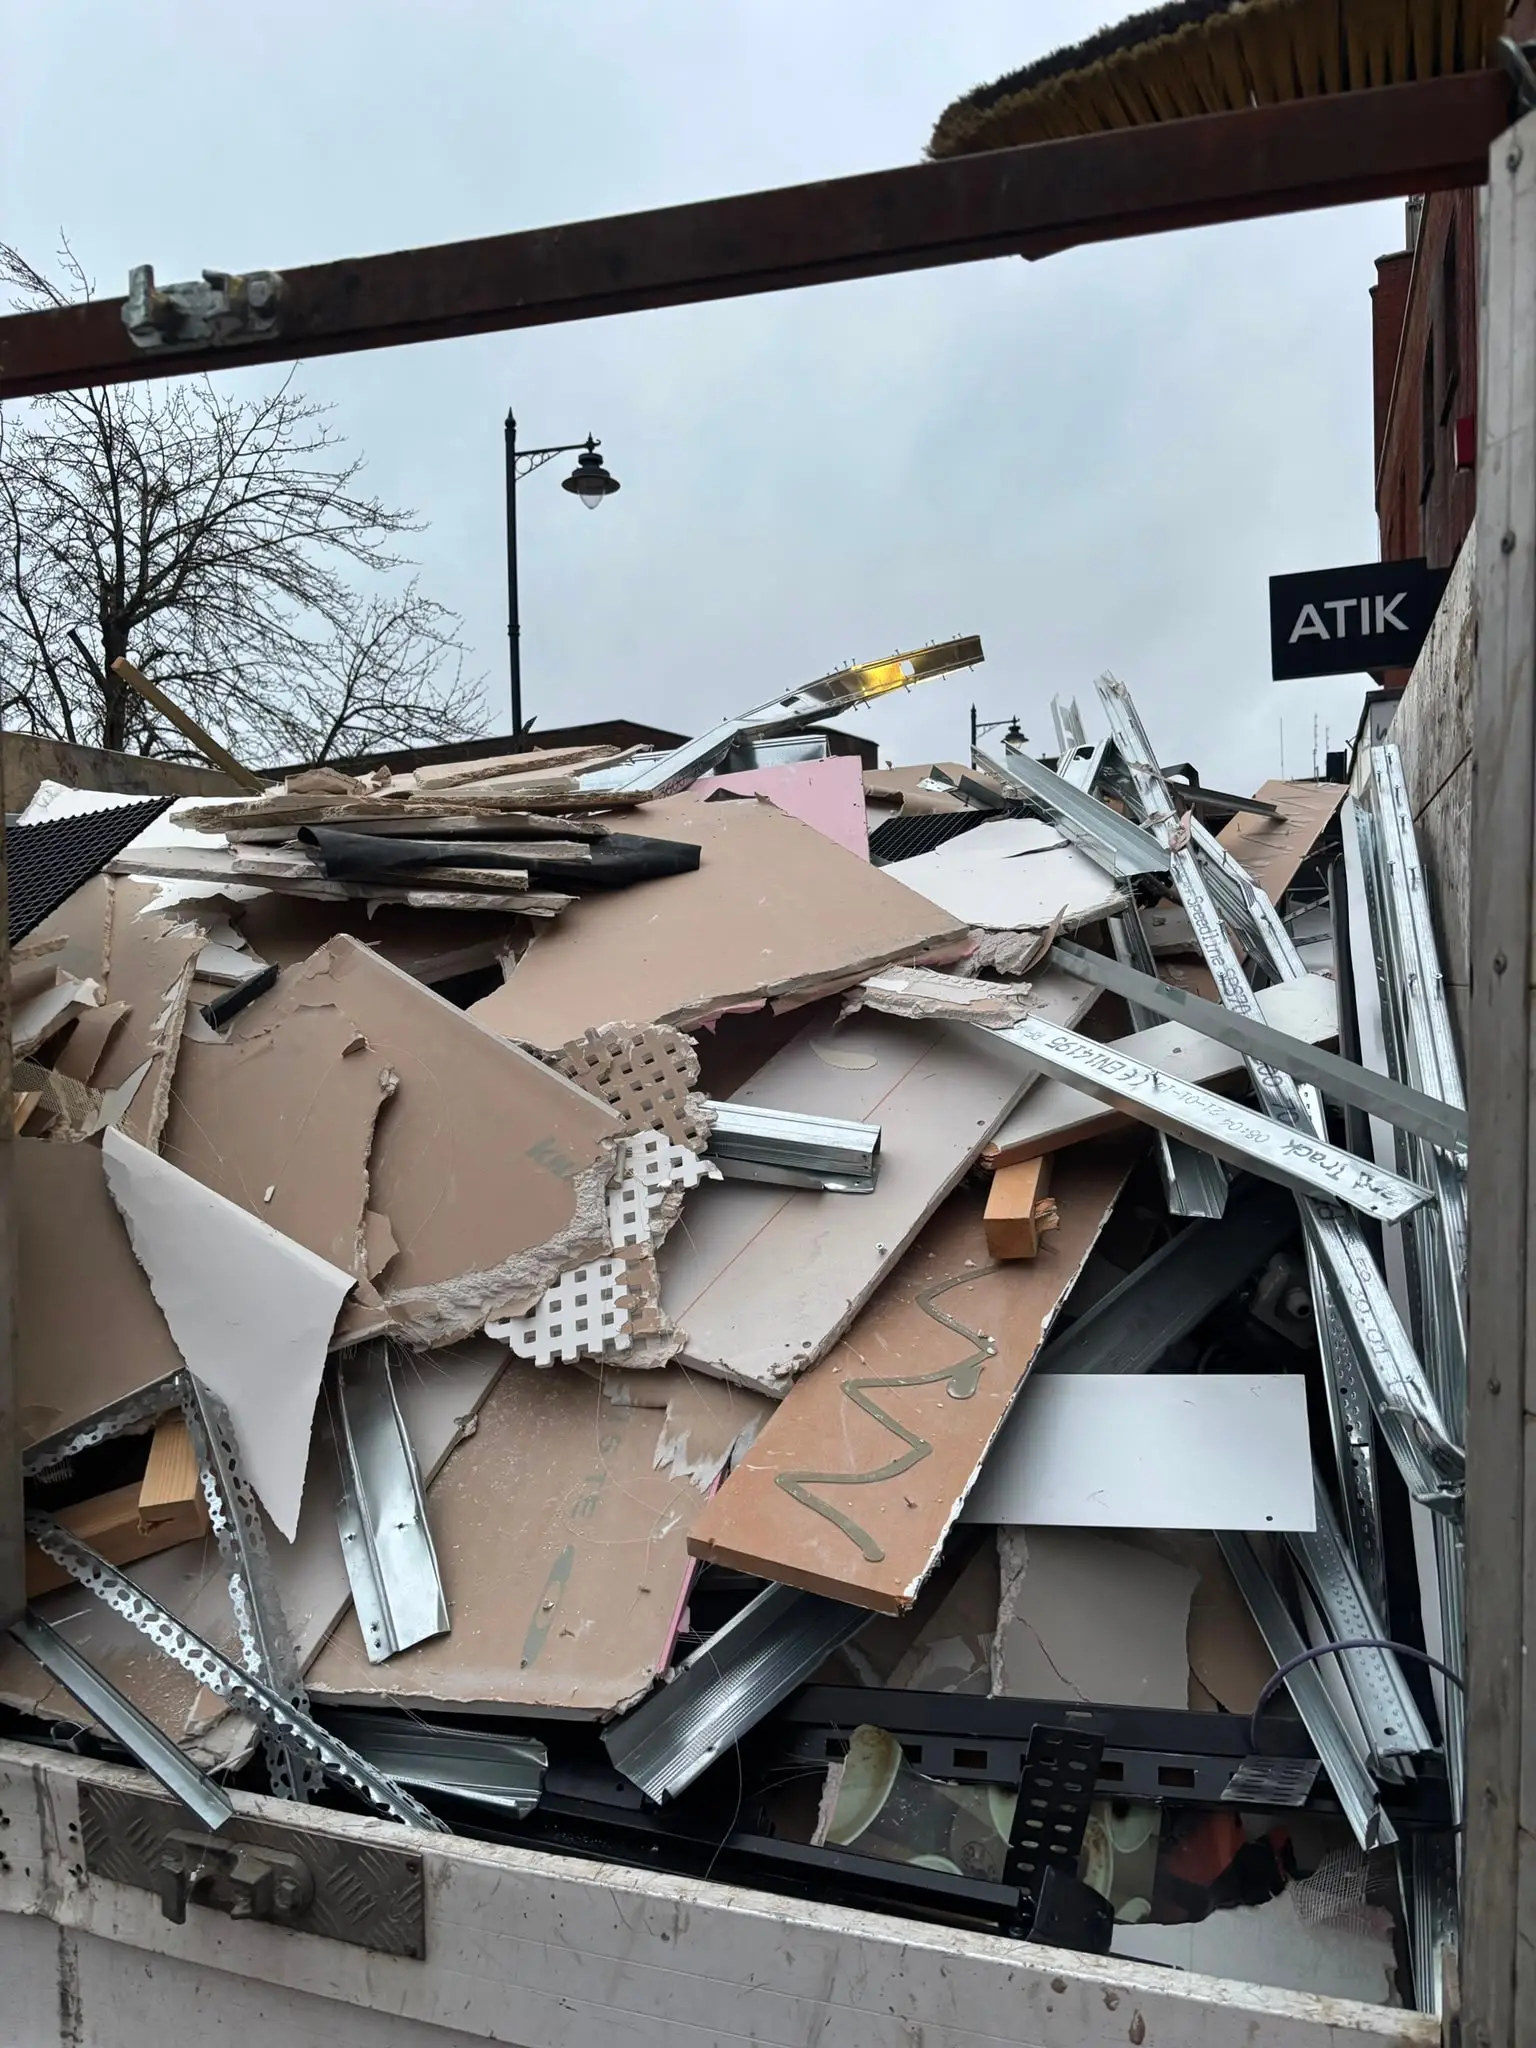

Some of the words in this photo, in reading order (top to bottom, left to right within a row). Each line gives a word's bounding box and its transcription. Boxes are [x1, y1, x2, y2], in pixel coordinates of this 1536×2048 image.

[1288, 592, 1409, 644] ATIK
[1187, 895, 1226, 967] Speedline
[1045, 1036, 1126, 1074] EN14195
[1219, 1118, 1270, 1144] 08:04
[1280, 1139, 1348, 1182] Track
